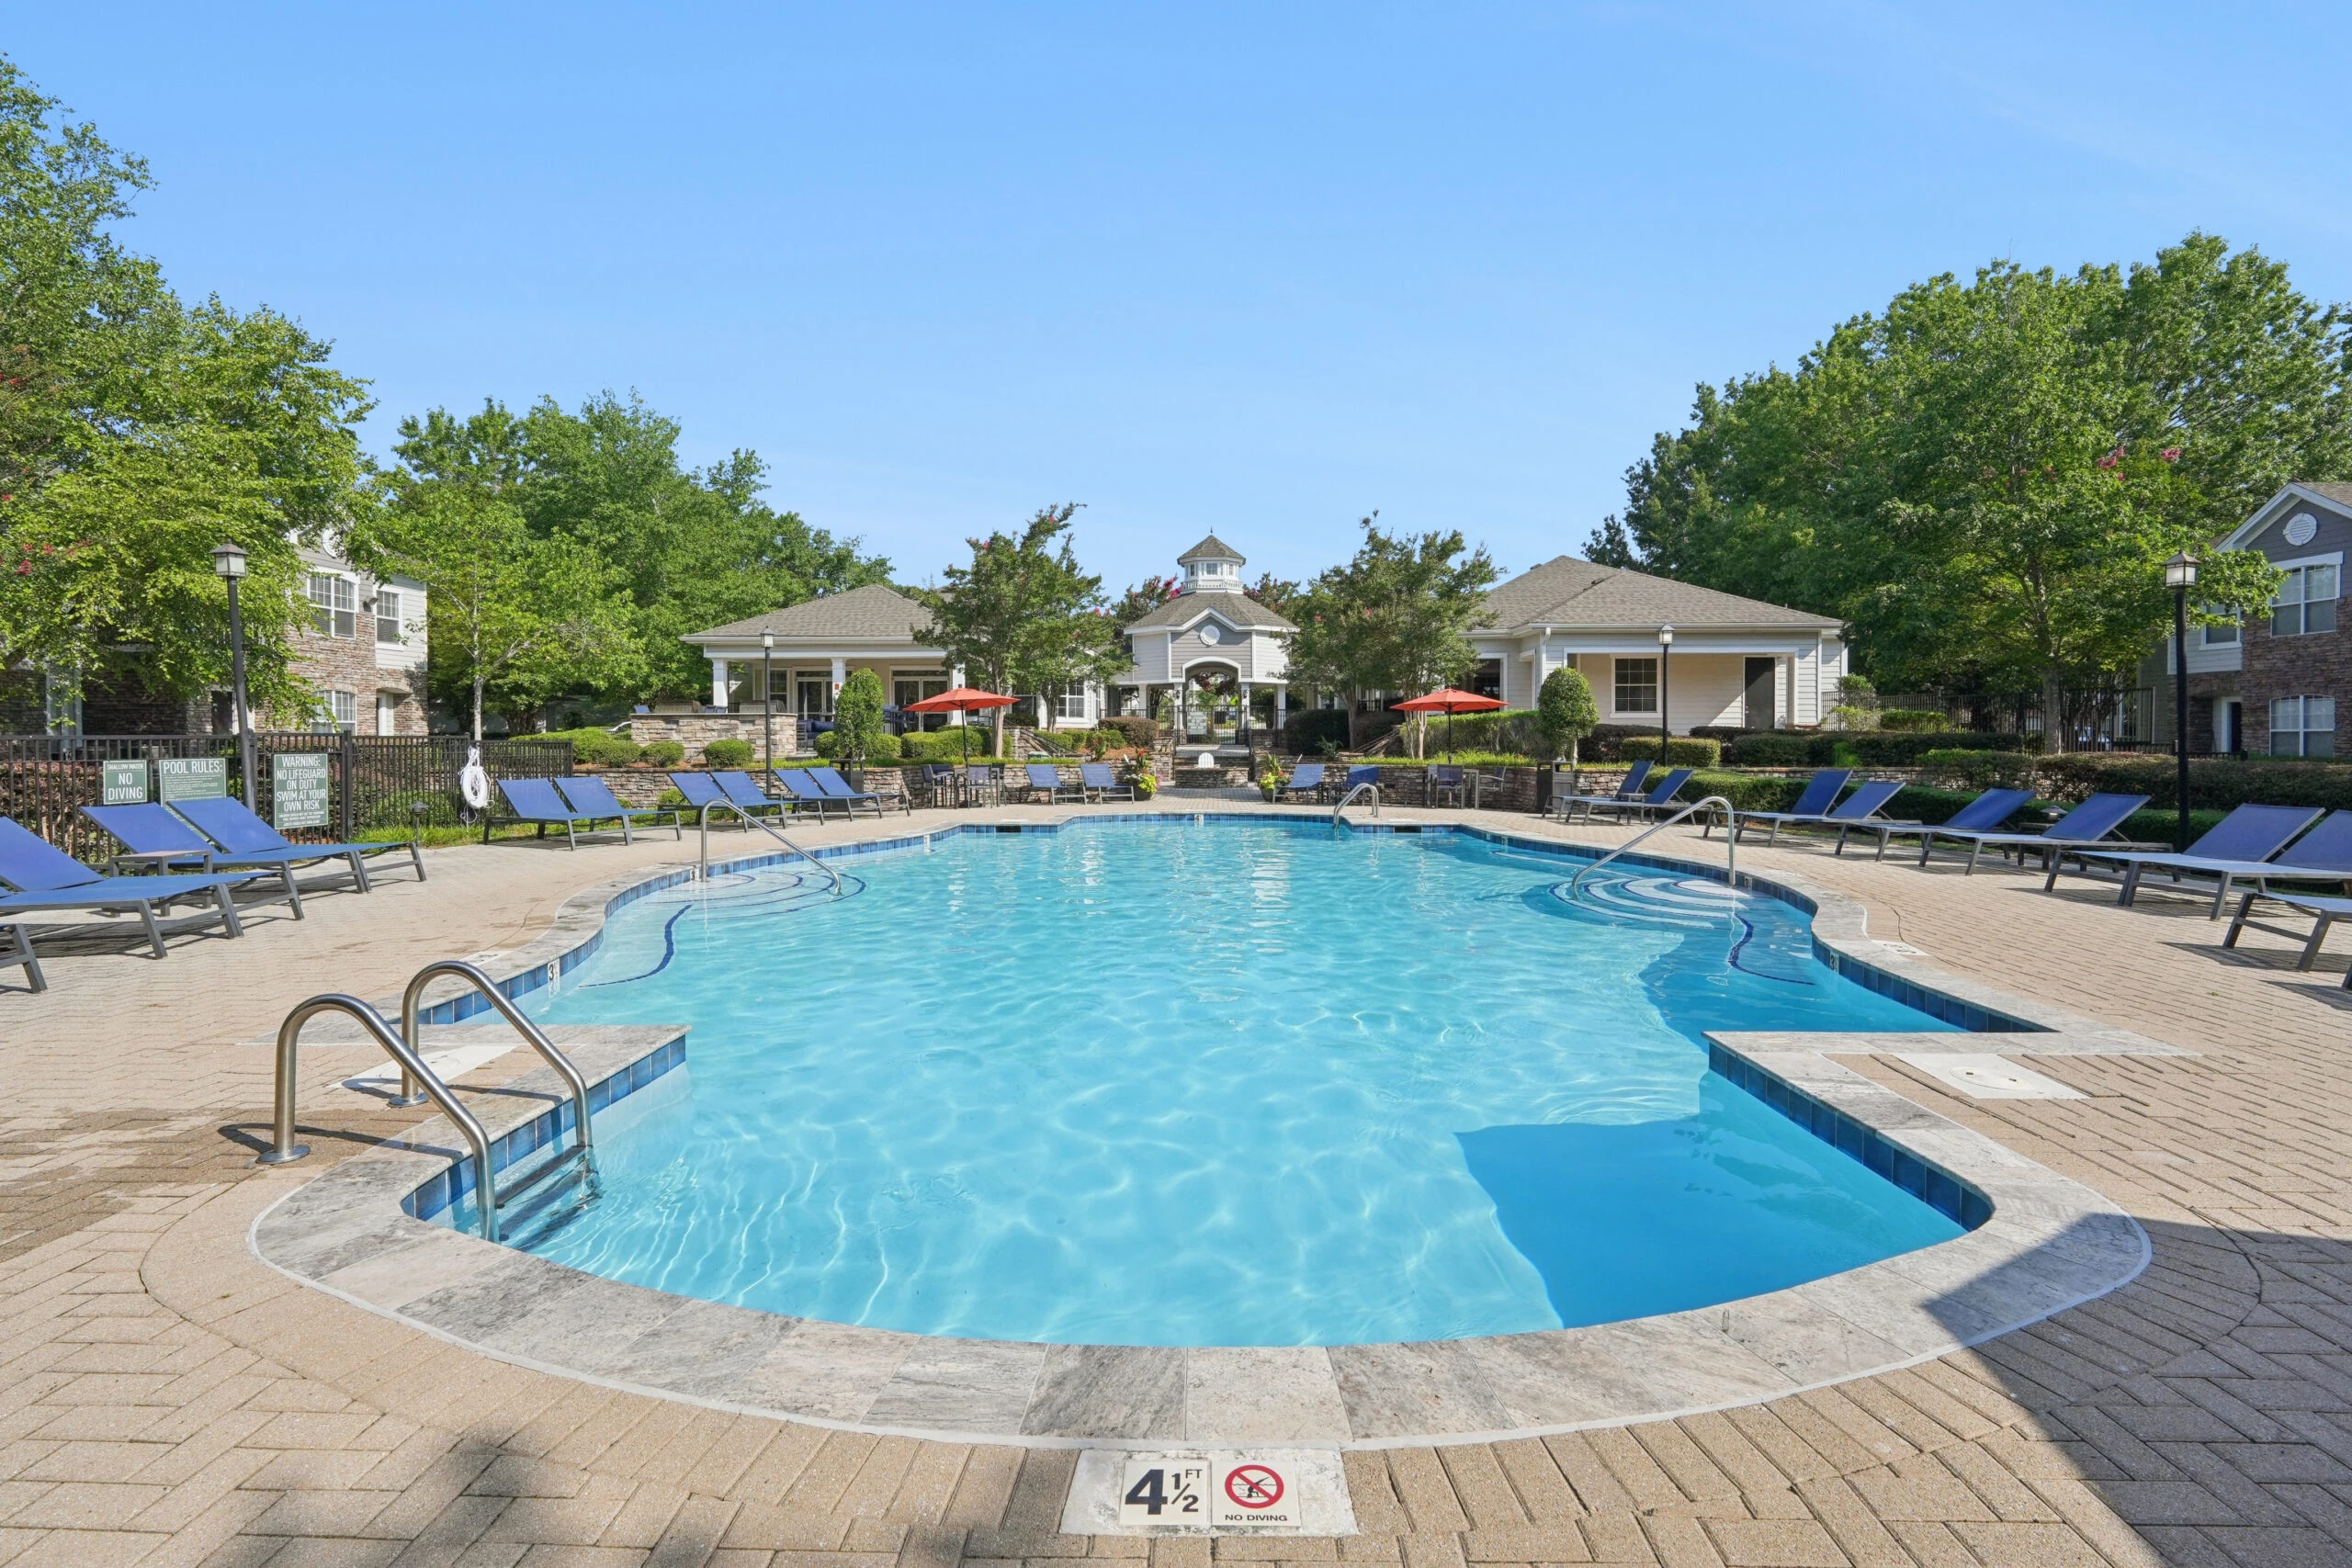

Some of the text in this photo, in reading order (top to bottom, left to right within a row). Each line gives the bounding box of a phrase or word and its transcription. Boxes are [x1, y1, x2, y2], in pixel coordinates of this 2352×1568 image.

[163, 760, 223, 774] POOL RULES:
[282, 756, 321, 767] WARNING:
[118, 773, 133, 785] NO
[277, 769, 325, 780] NO LIFEGUARD
[286, 779, 317, 790] ON DUTY
[107, 786, 143, 800] DIVING
[277, 789, 326, 801] SWIM AT YOUR
[284, 800, 320, 811] OWN RISK
[548, 964, 555, 981] 3
[1185, 1469, 1203, 1479] FT
[1247, 1514, 1288, 1522] DIVING
